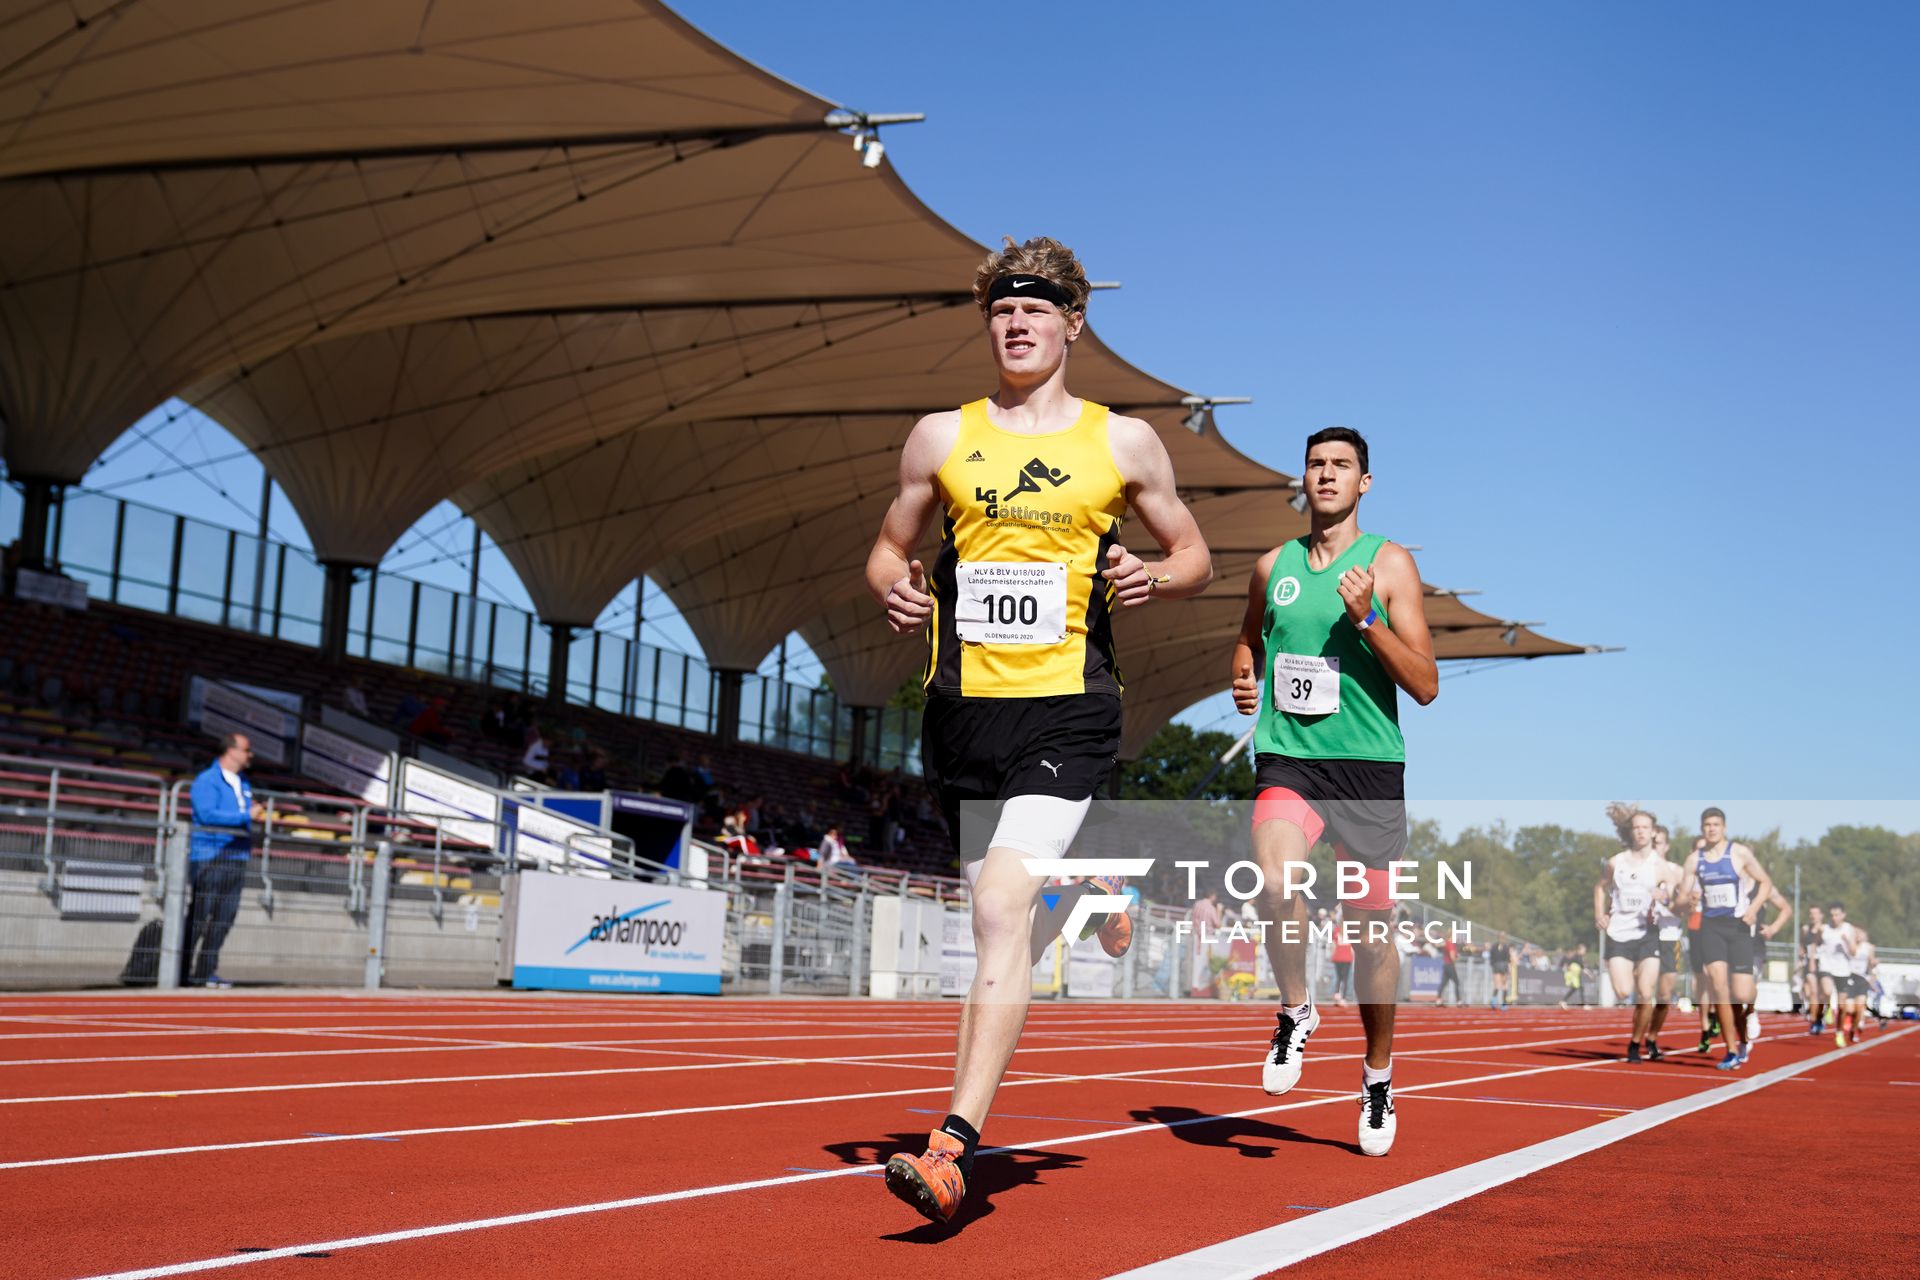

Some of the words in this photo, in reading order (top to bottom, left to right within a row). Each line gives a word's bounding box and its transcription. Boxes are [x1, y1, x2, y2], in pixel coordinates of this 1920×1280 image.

[976, 487, 997, 503] LG
[986, 504, 1073, 525] Göttingen
[968, 577, 1054, 586] Landesmeisterschaften
[974, 568, 988, 576] NLV
[989, 568, 995, 576] &
[996, 568, 1010, 576] BLV
[1012, 569, 1045, 577] U18/U20
[983, 594, 1038, 625] 100
[1291, 678, 1312, 701] 39
[589, 905, 682, 954] ashampoo
